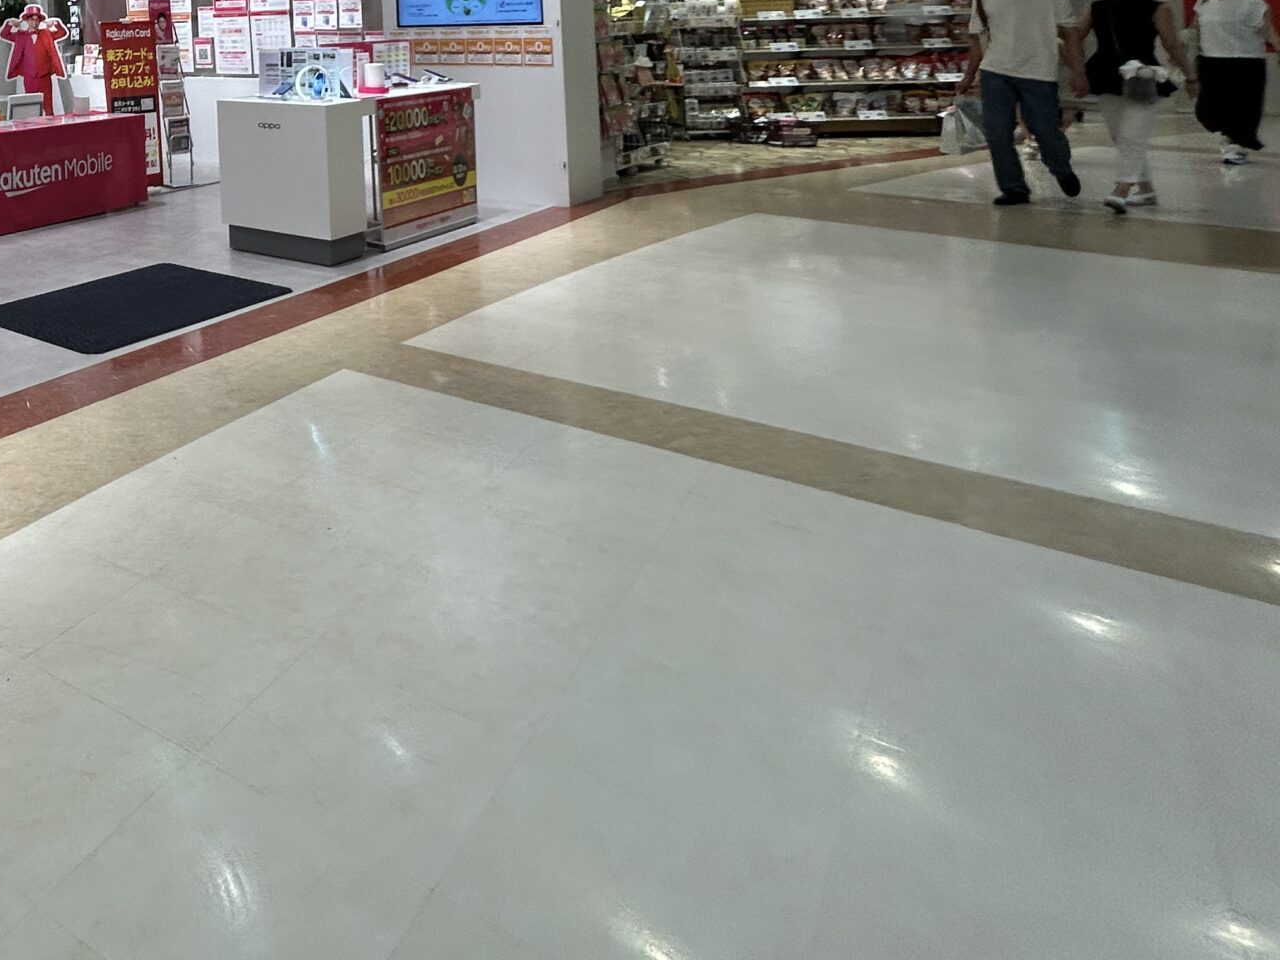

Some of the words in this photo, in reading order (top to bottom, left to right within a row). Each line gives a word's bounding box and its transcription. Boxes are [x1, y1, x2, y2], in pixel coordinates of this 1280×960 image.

[106, 29, 134, 39] Rakuten
[135, 28, 151, 38] Card
[106, 47, 153, 61] 楽天カードは
[112, 62, 150, 75] ショップで
[110, 76, 155, 89] お申し込み!
[64, 151, 113, 180] Mobile
